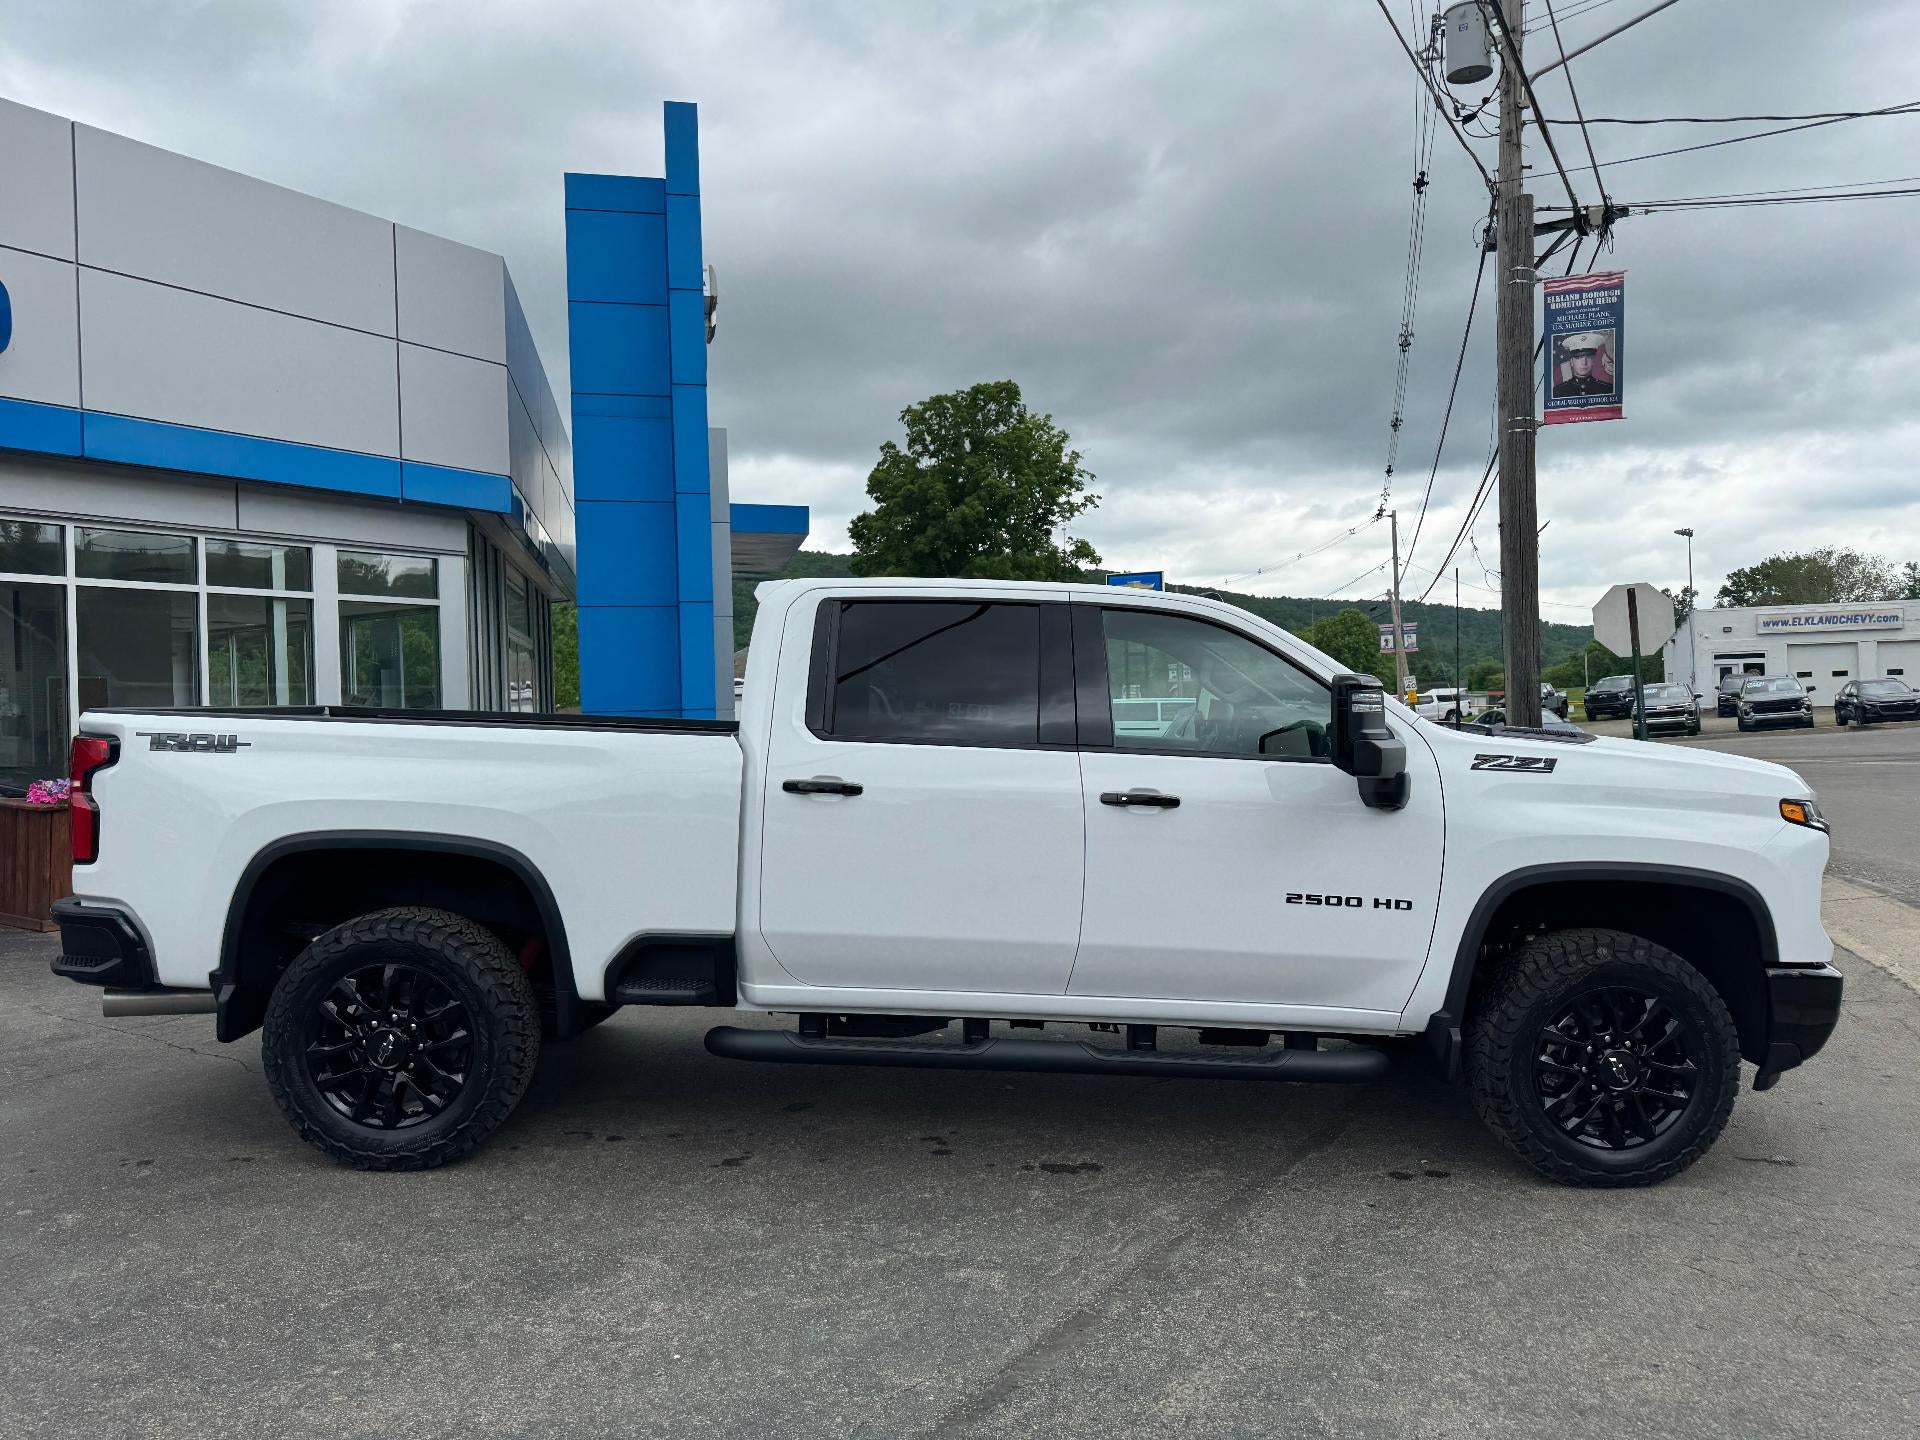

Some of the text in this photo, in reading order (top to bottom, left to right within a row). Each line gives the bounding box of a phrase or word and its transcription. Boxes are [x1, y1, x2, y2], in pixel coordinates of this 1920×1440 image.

[1547, 289, 1620, 303] ELKLAND BOROUGH
[1550, 296, 1617, 309] HOMETOWN HERO
[1556, 313, 1587, 322] MICHAEL
[1565, 321, 1591, 329] MARINE
[1762, 613, 1899, 628] www.ELKLANDCHEVY.com
[1470, 754, 1558, 773] Z71
[1285, 892, 1413, 911] 2500 HD
